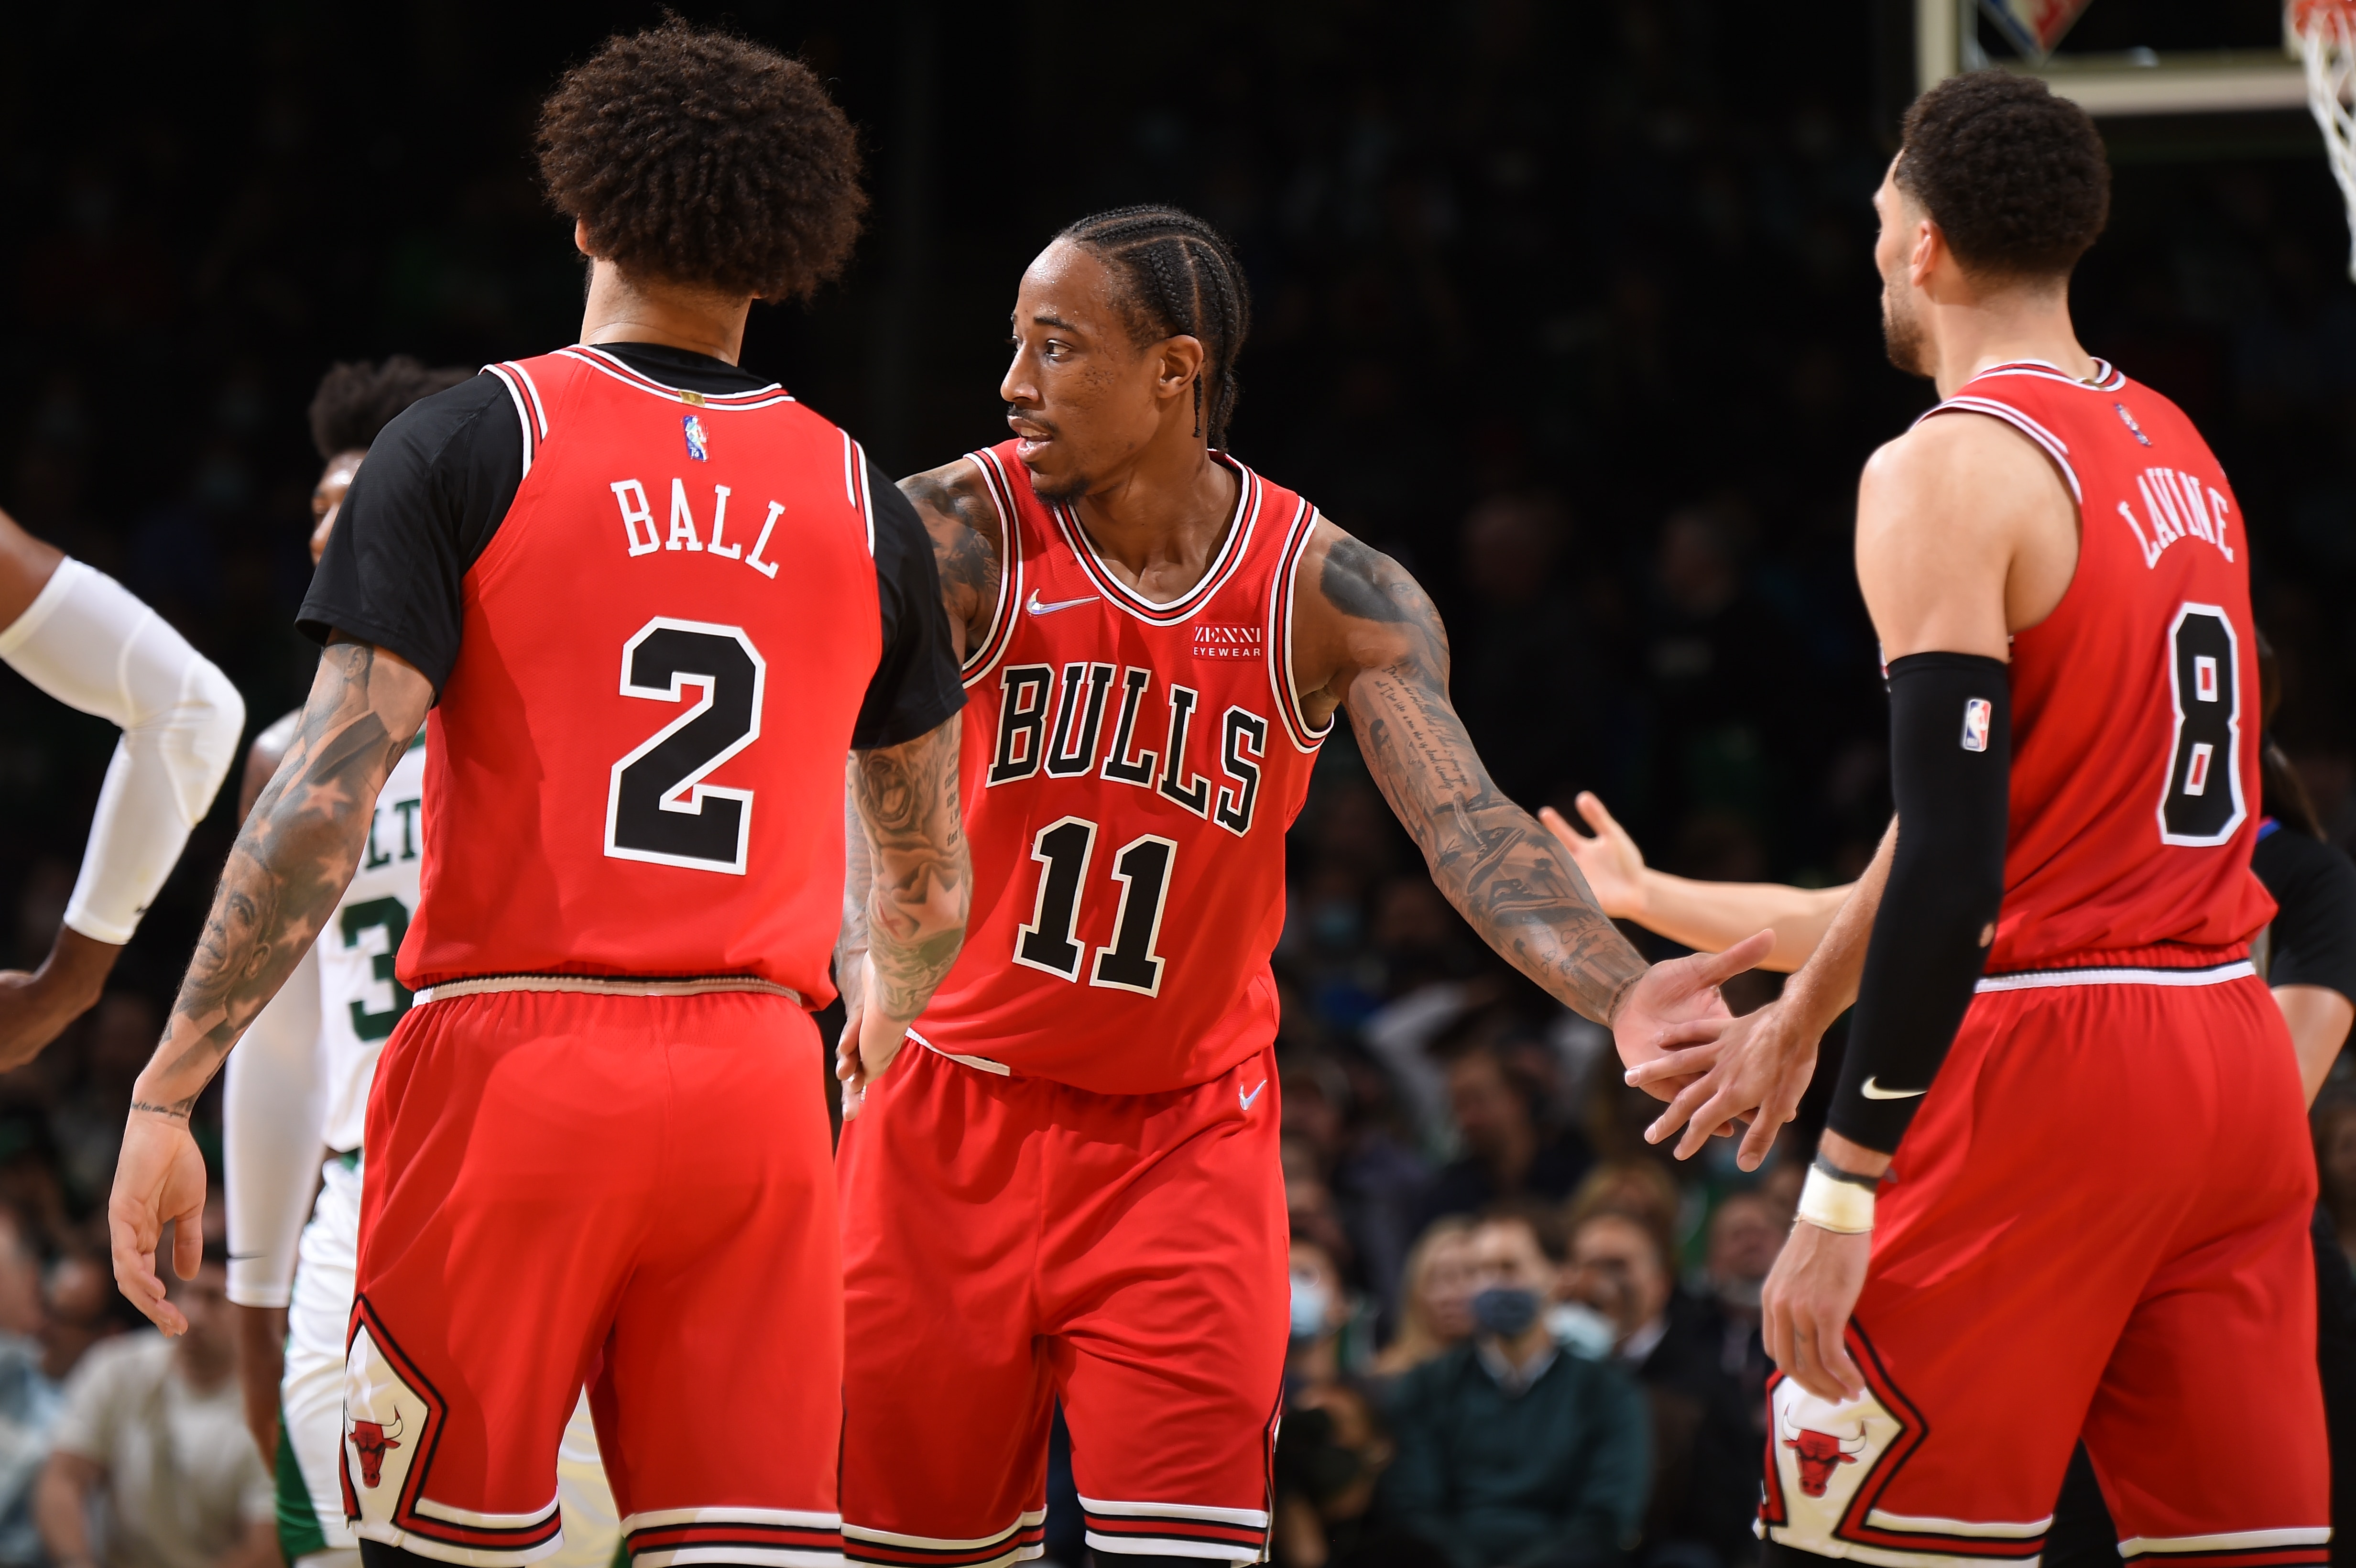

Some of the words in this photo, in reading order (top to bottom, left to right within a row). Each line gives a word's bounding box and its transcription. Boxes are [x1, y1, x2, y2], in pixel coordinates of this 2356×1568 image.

[610, 478, 785, 579] BALL
[2117, 468, 2234, 569] LAVINE
[1193, 647, 1261, 656] EYEWEAR
[1195, 626, 1260, 642] ZENNI
[604, 616, 766, 875] 2
[986, 662, 1268, 838] BULLS
[2156, 602, 2247, 847] 8
[1012, 816, 1178, 999] 11
